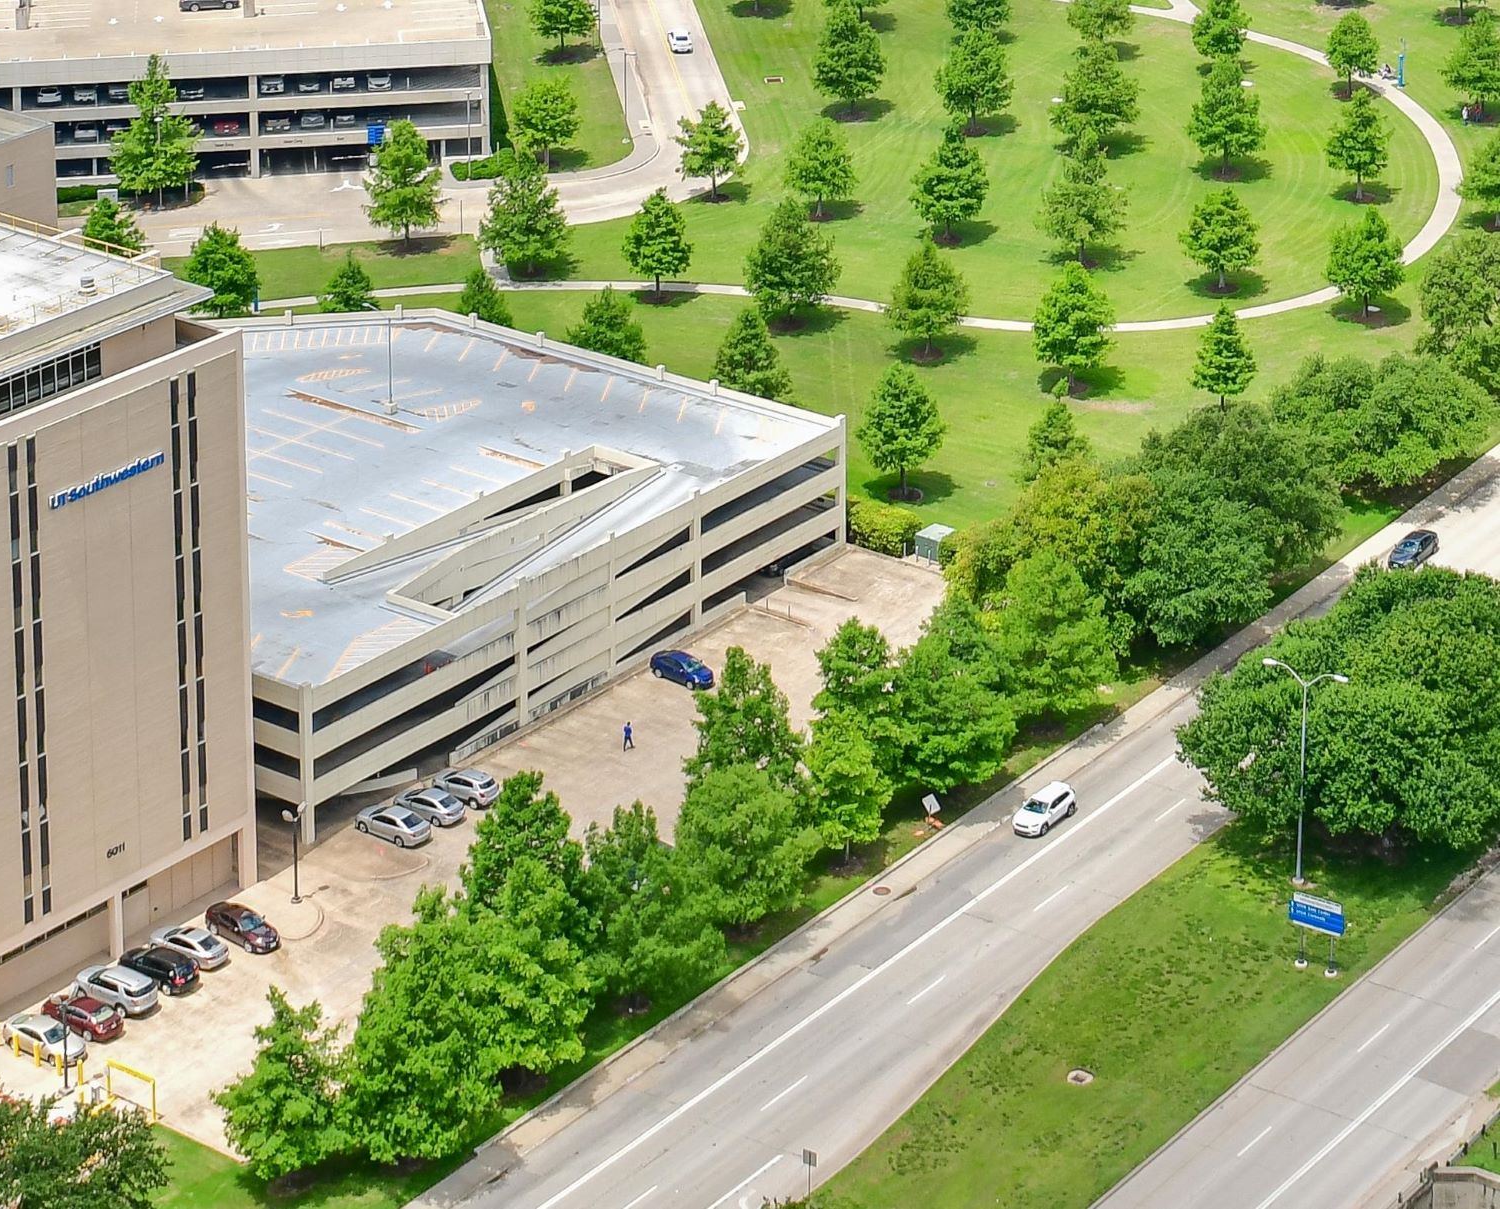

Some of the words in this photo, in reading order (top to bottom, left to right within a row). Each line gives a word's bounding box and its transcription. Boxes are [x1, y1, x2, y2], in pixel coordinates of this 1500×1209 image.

[48, 490, 68, 510] UT
[67, 451, 165, 503] Southwestern
[106, 841, 126, 859] 6011
